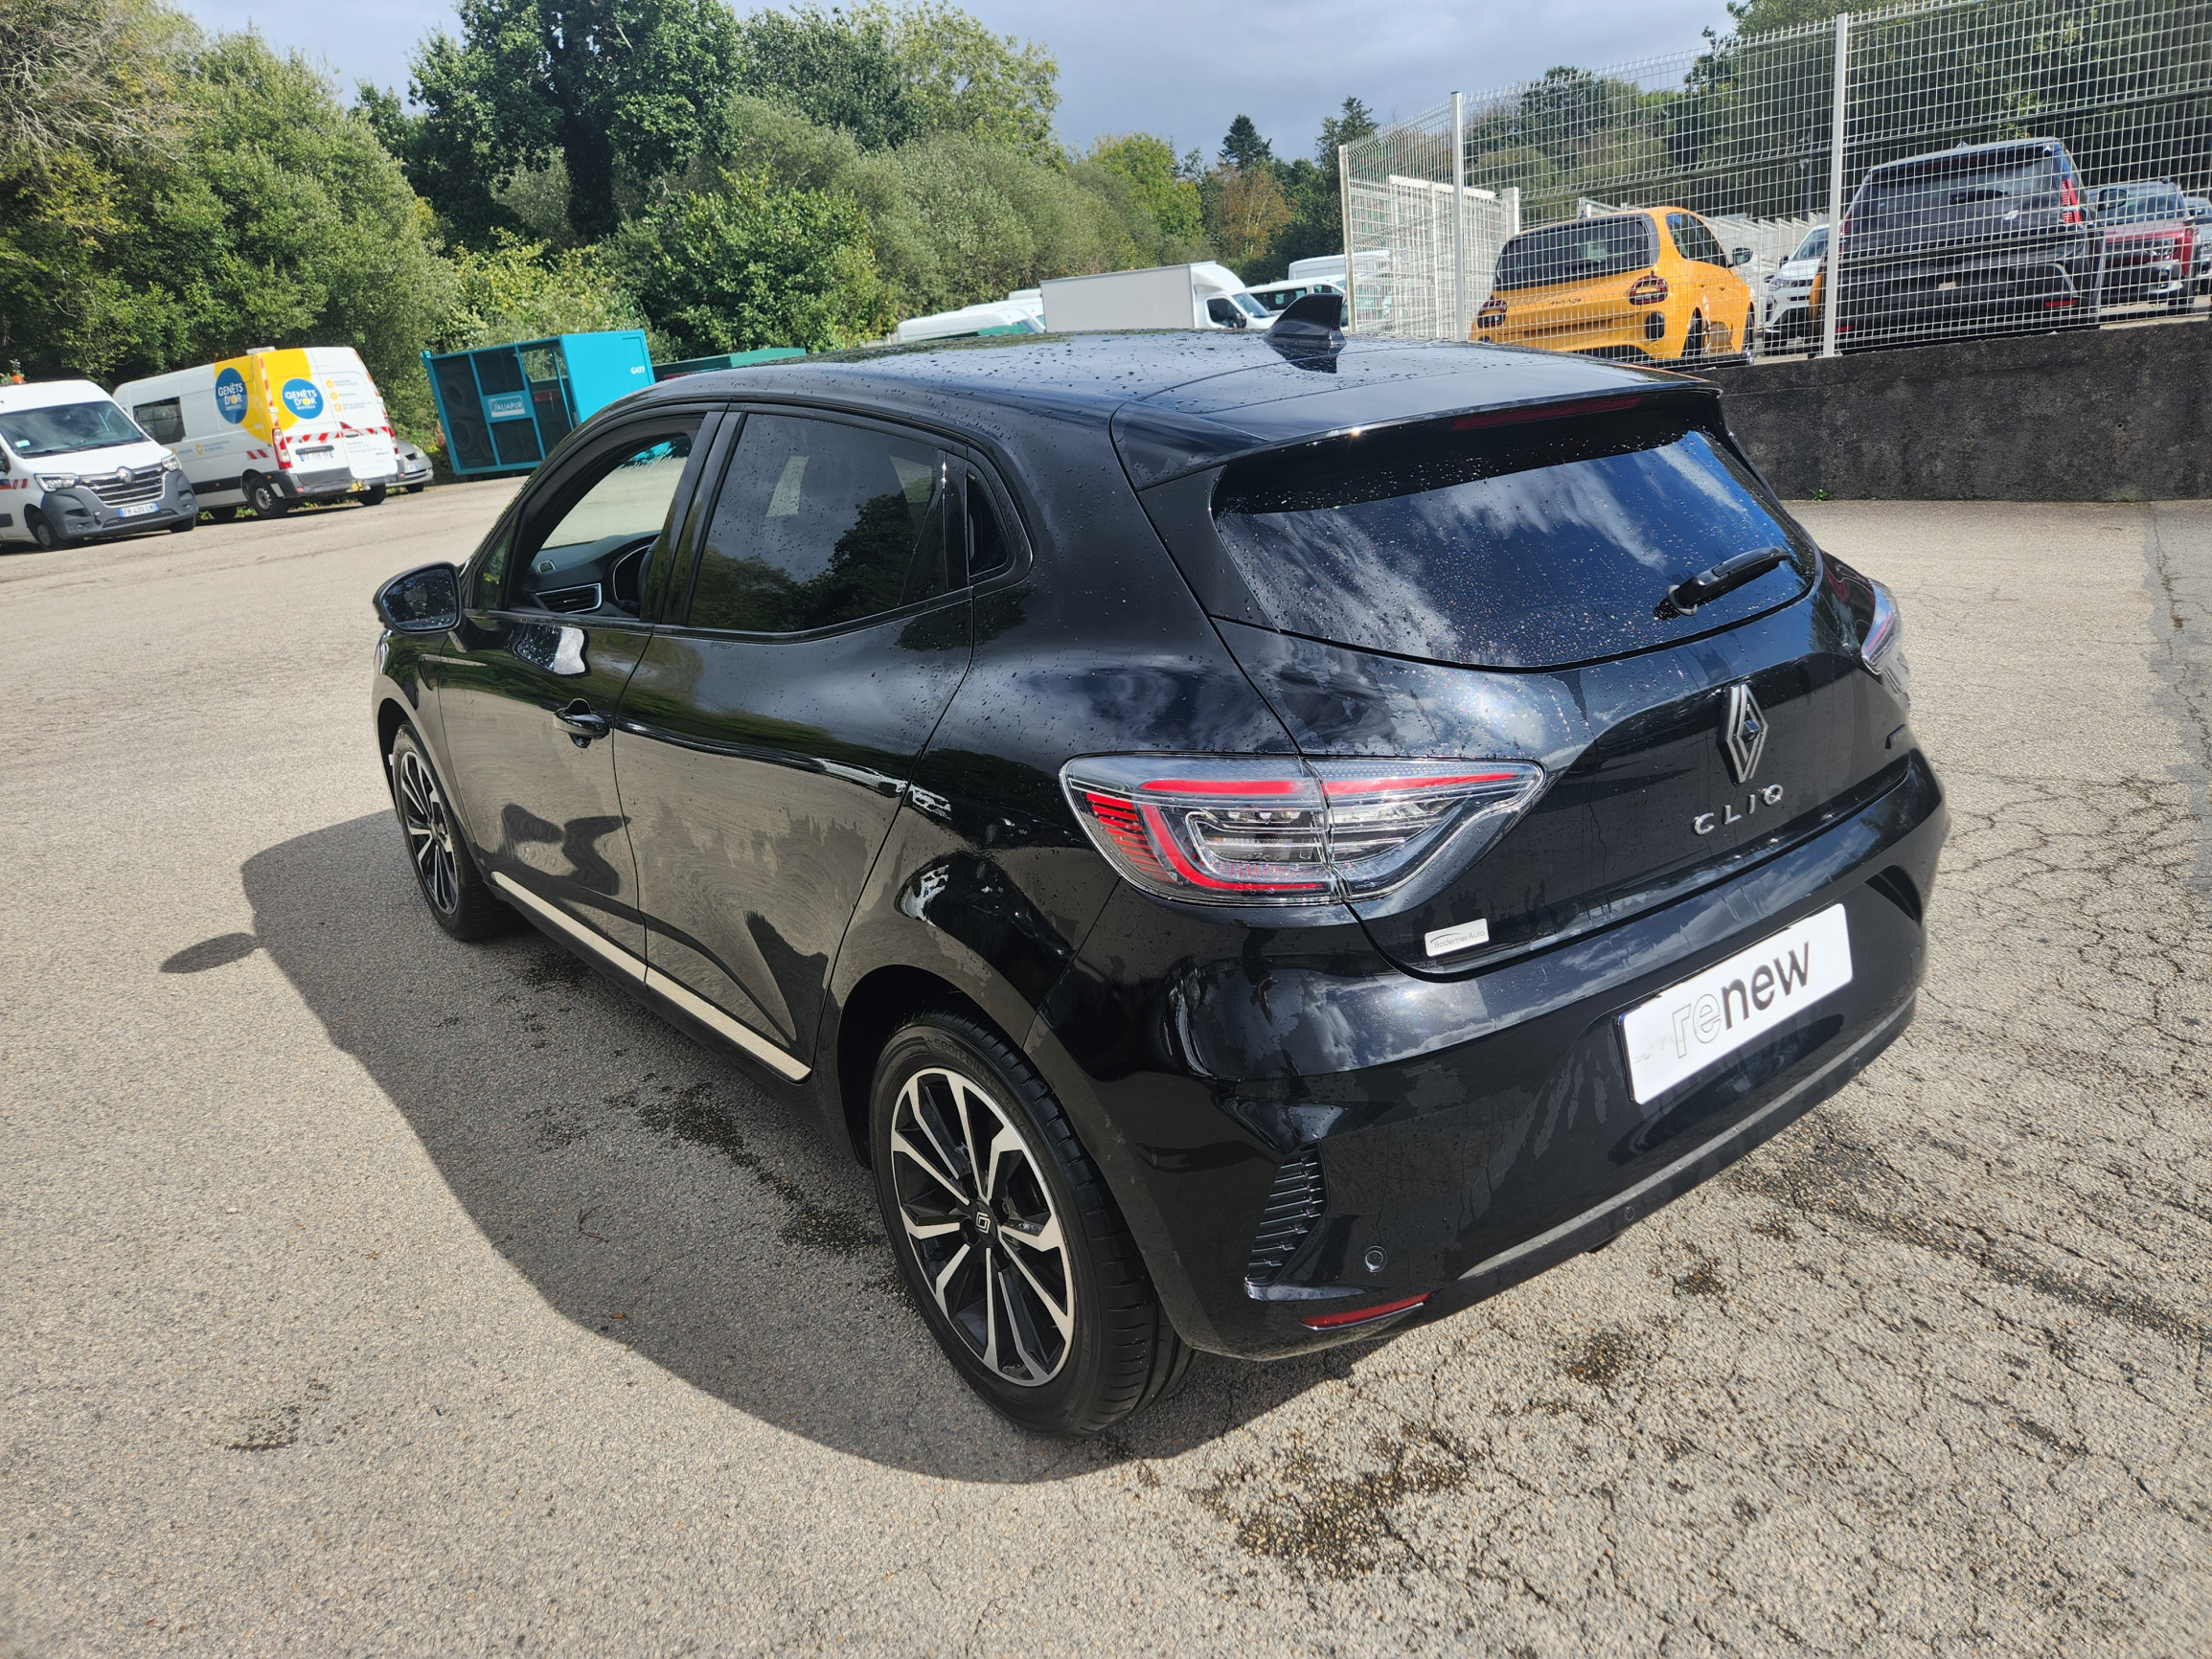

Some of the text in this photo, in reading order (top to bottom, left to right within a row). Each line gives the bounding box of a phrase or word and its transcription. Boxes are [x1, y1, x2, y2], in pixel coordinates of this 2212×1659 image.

[218, 382, 243, 397] GENÊTS
[285, 389, 317, 399] GENÊTS
[1694, 784, 1784, 835] CLIO
[1672, 941, 1810, 1059] renew
